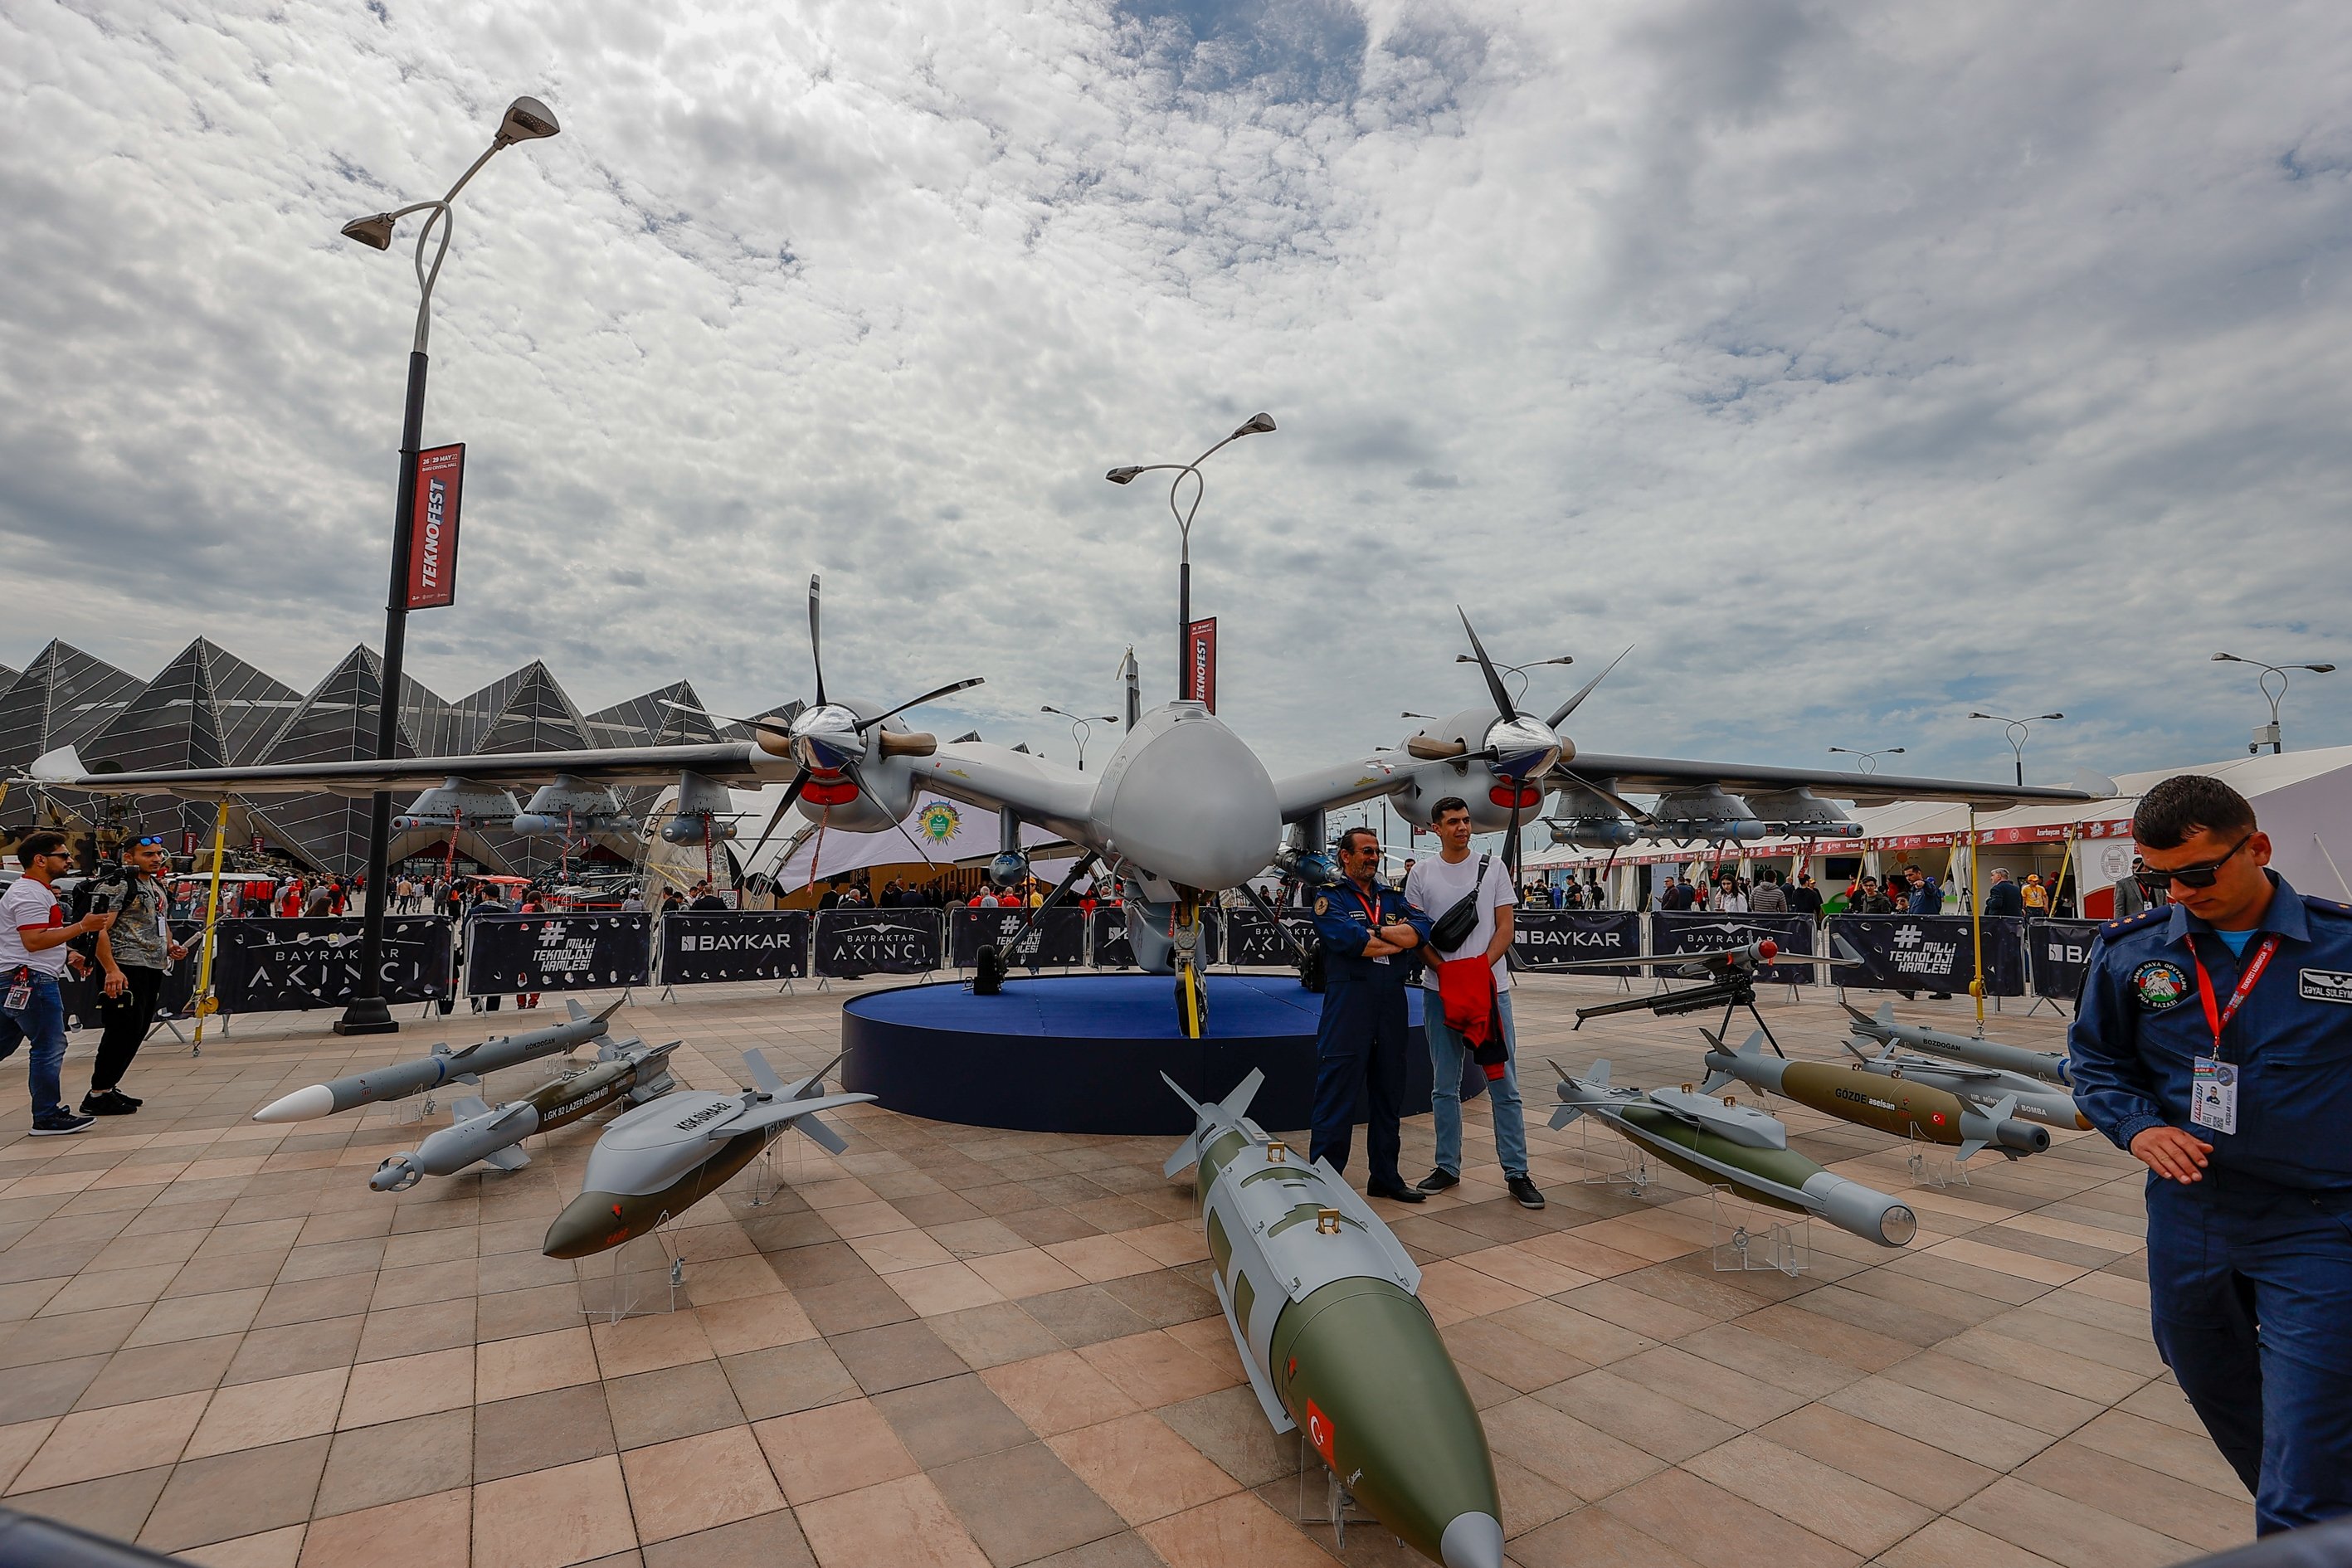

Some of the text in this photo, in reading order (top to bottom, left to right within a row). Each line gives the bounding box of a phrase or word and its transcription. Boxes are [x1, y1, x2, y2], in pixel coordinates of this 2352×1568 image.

[421, 479, 445, 588] TEKNOFEST
[1196, 639, 1206, 700] EKNOFEST
[699, 933, 791, 951] BAYKAR
[847, 934, 915, 943] BAYRAKTAR
[1531, 931, 1621, 947] BAYKAR
[532, 948, 594, 962] TEKNOLOJİ
[833, 944, 927, 961] AKINCI
[1888, 950, 1954, 964] TEKNOLOJİ
[539, 960, 591, 972] HAMLESİ
[1897, 961, 1952, 975] HAMLESİ
[2137, 993, 2150, 1004] PUA
[1834, 1087, 1867, 1104] GÖZDE
[543, 1108, 558, 1122] LGK
[558, 1104, 565, 1115] 82
[565, 1098, 583, 1113] LAZER
[1868, 1097, 1896, 1111] aselsan
[2021, 1104, 2048, 1117] BOMBA
